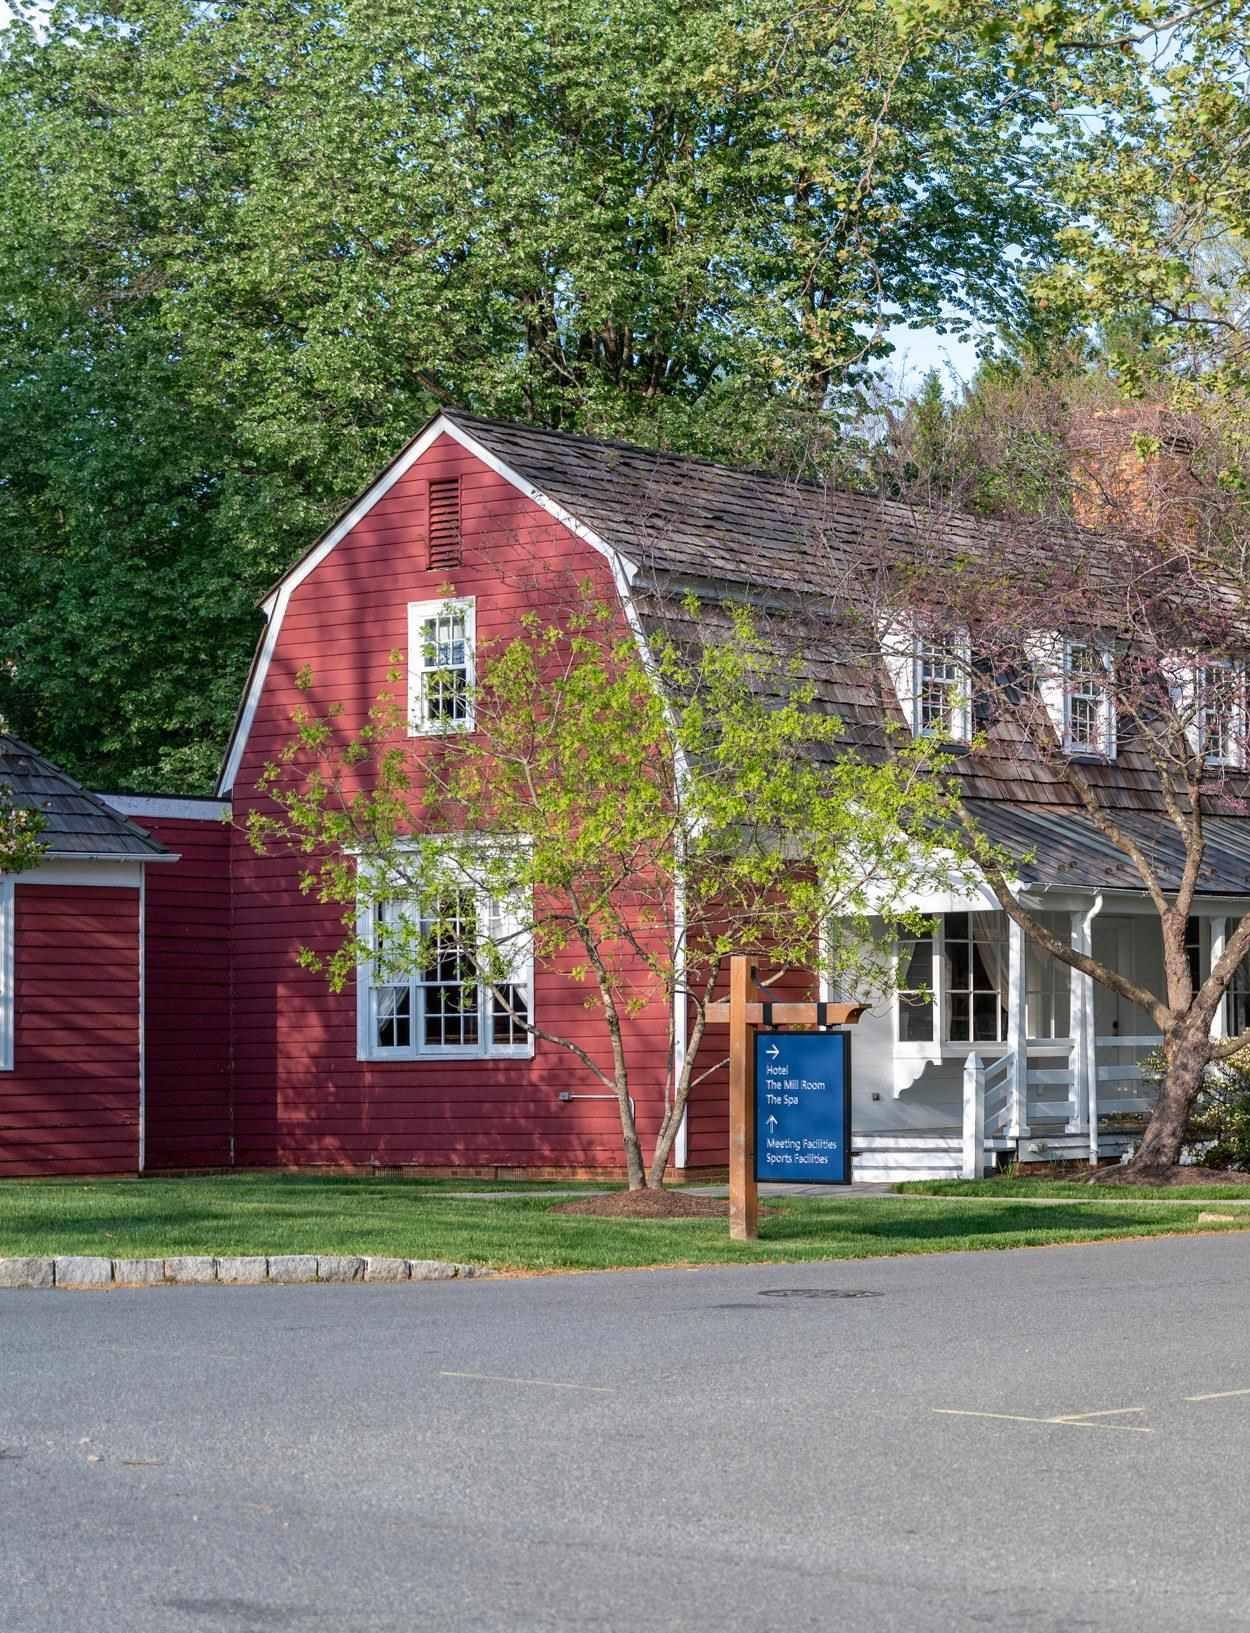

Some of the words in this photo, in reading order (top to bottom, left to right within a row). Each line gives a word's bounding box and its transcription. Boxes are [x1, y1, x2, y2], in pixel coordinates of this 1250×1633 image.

[766, 1064, 789, 1076] Hotel
[766, 1079, 782, 1090] The
[783, 1079, 799, 1090] Mill
[800, 1079, 826, 1090] Room
[766, 1094, 782, 1105] The
[783, 1094, 799, 1107] Spa
[766, 1138, 801, 1151] Meeting
[803, 1138, 838, 1150] Facilities
[766, 1152, 793, 1165] Sports
[794, 1152, 829, 1164] Facilities
